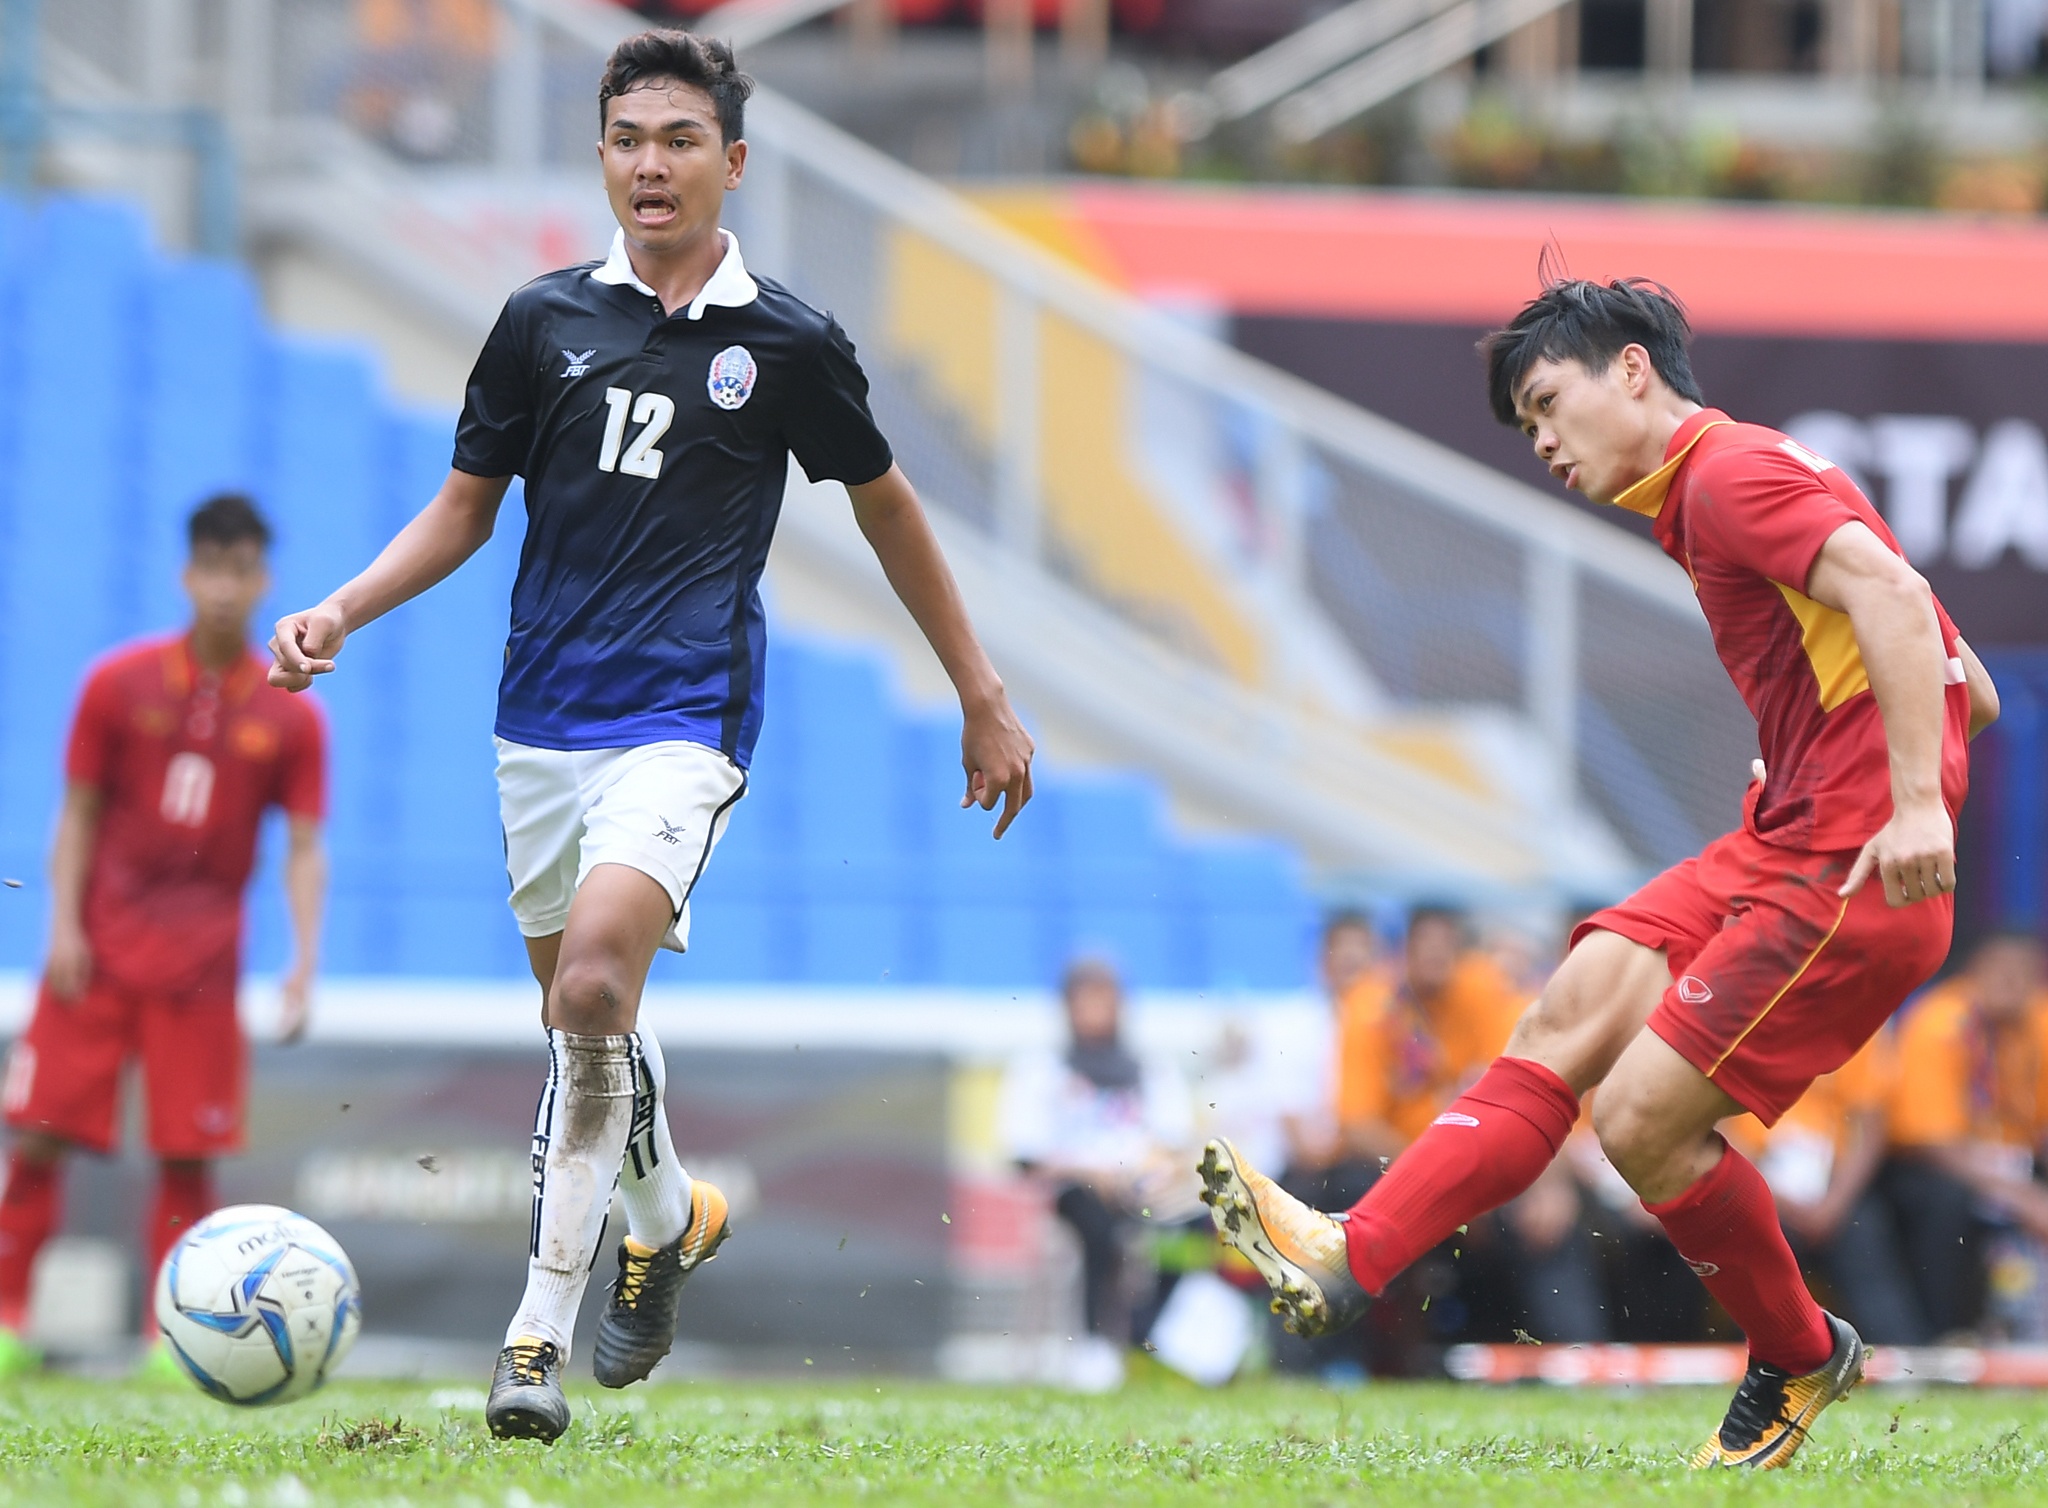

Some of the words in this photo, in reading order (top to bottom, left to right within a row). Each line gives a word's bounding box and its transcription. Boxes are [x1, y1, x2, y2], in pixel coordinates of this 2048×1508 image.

[560, 364, 591, 378] FBT
[598, 386, 675, 480] 12
[651, 830, 682, 845] FBT
[531, 1133, 550, 1198] FBT
[238, 1220, 303, 1256] molt
